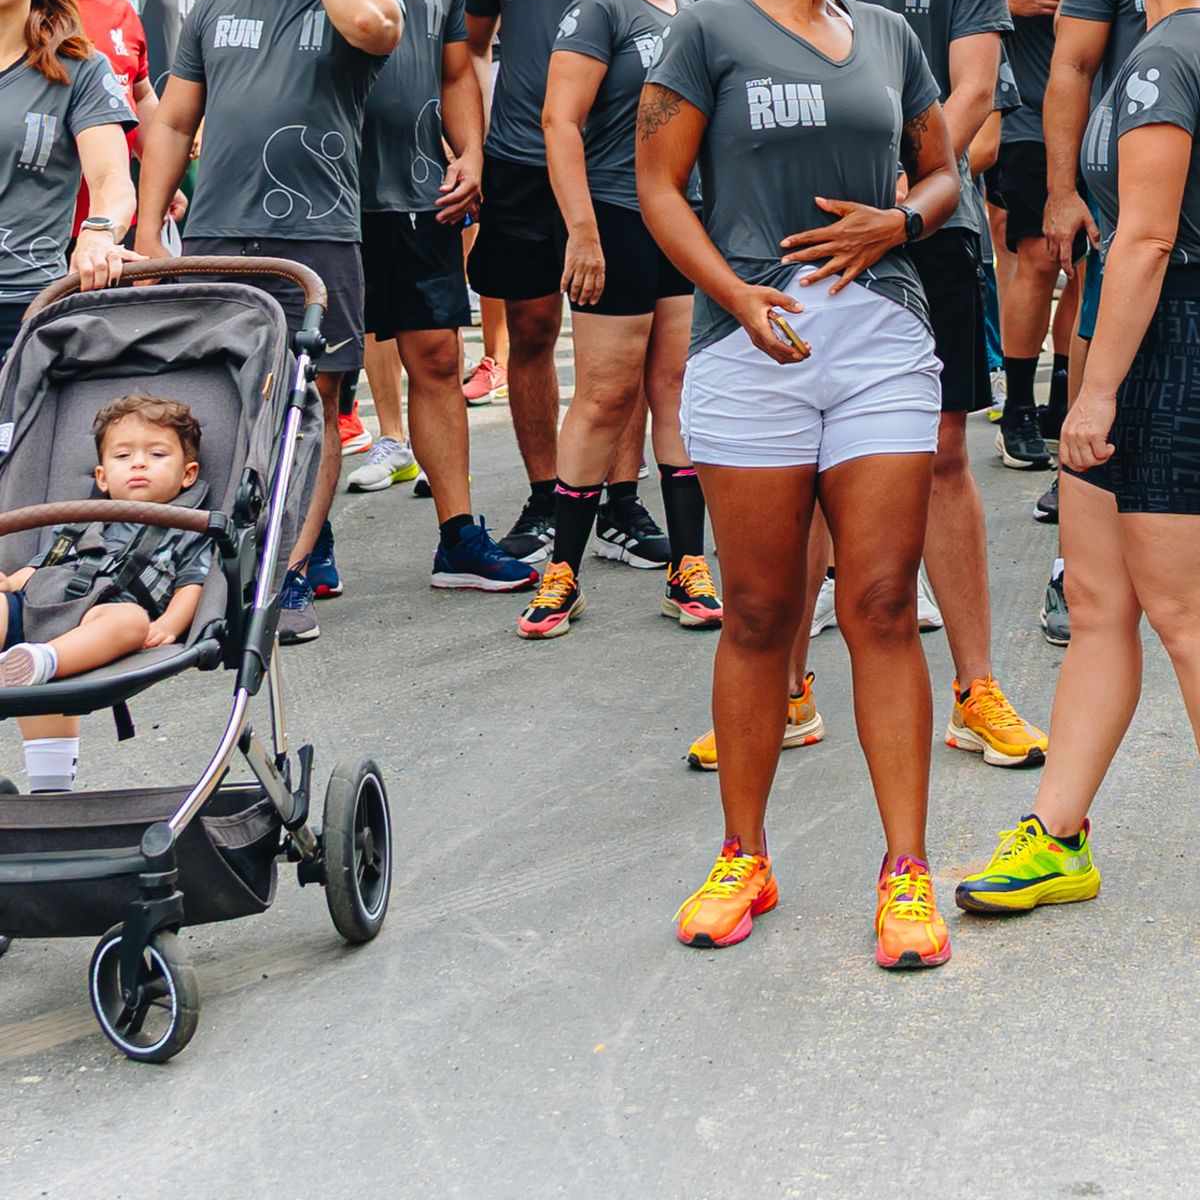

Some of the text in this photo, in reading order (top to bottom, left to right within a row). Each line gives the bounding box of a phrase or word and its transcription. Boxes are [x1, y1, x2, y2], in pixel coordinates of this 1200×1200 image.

[213, 18, 264, 49] RUN
[300, 9, 326, 47] 11
[745, 77, 773, 88] smart
[747, 83, 828, 131] RUN
[19, 112, 58, 167] 11
[1087, 105, 1113, 165] 11
